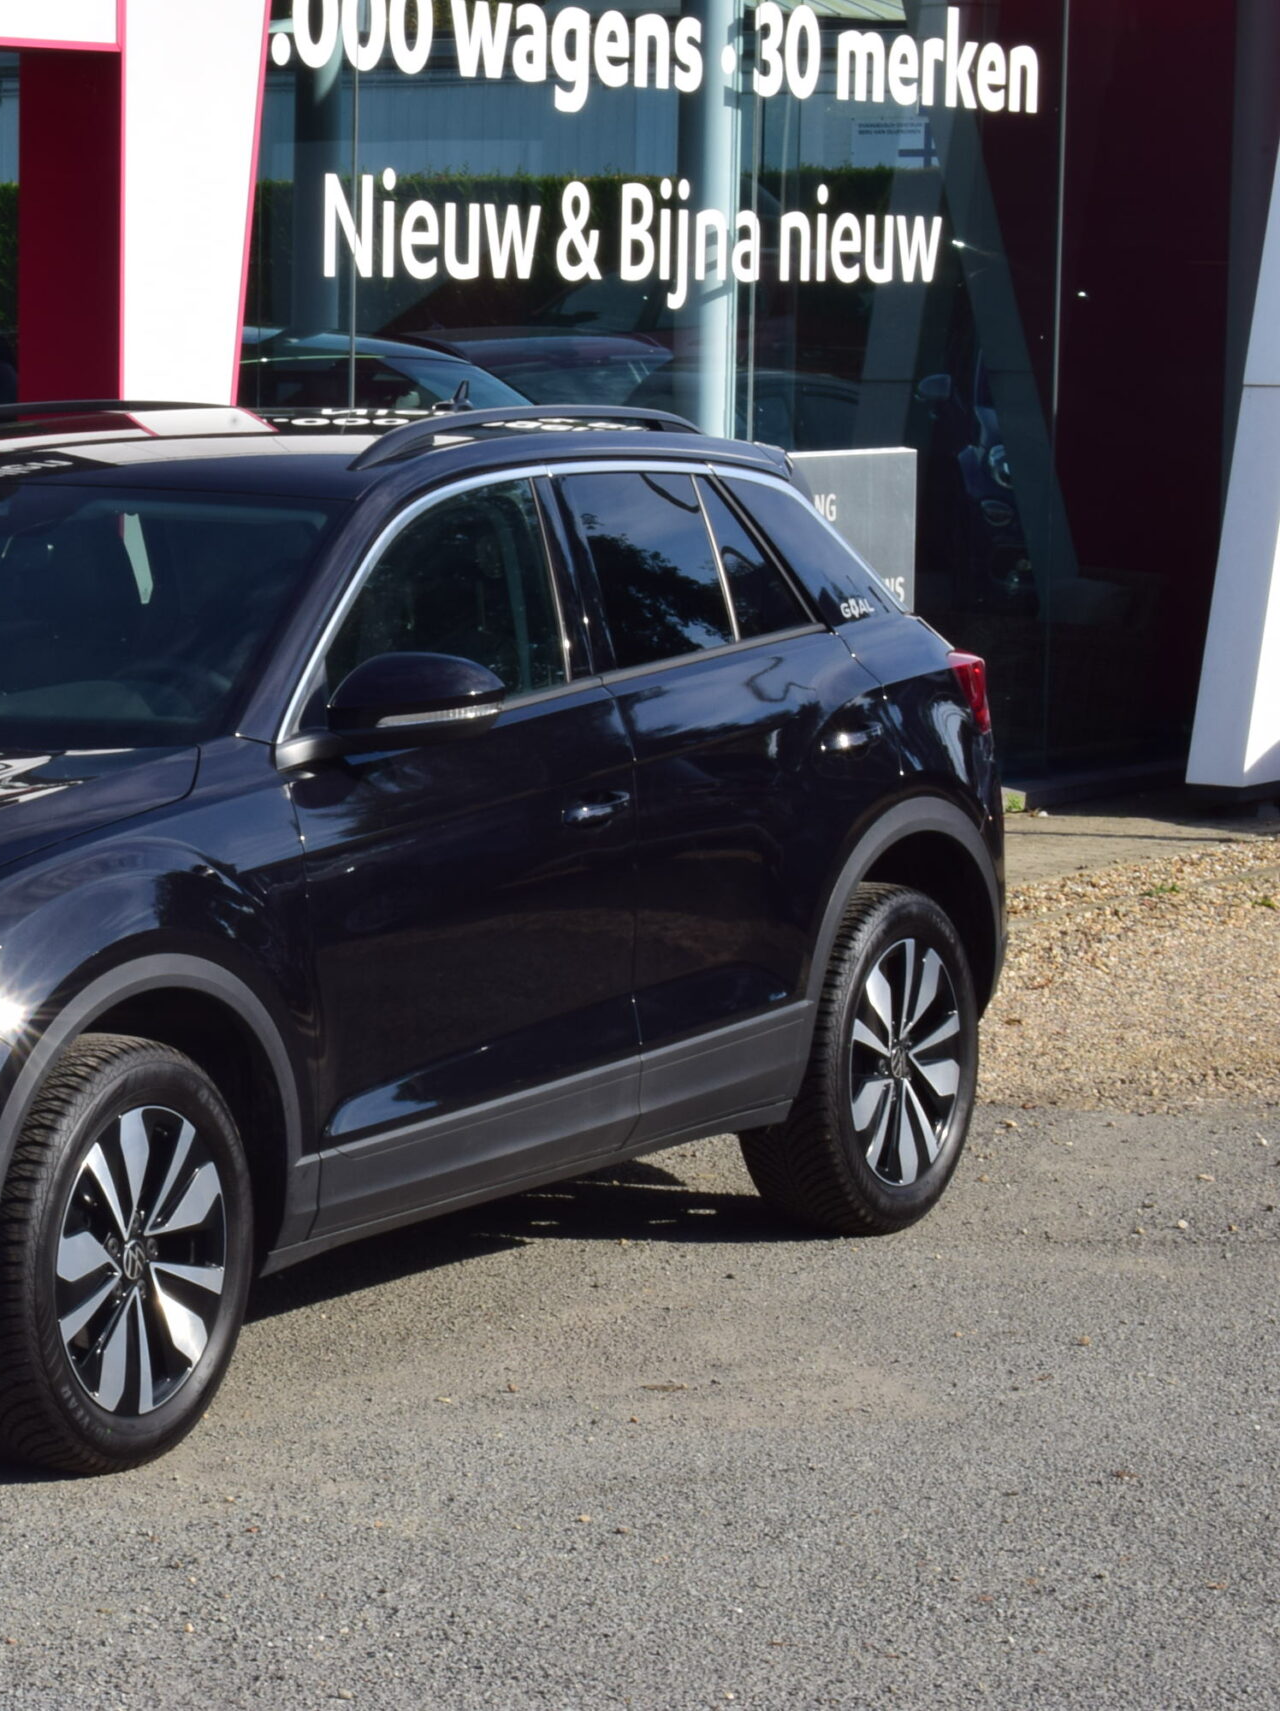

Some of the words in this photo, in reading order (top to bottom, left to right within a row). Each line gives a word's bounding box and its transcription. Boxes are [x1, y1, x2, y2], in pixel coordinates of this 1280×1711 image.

[450, 0, 703, 113] wagens
[753, 1, 821, 99] 30
[836, 6, 1038, 113] merken
[323, 167, 541, 281] Nieuw
[556, 181, 602, 281] &
[620, 178, 760, 309] Bijna
[779, 184, 942, 283] nieuw
